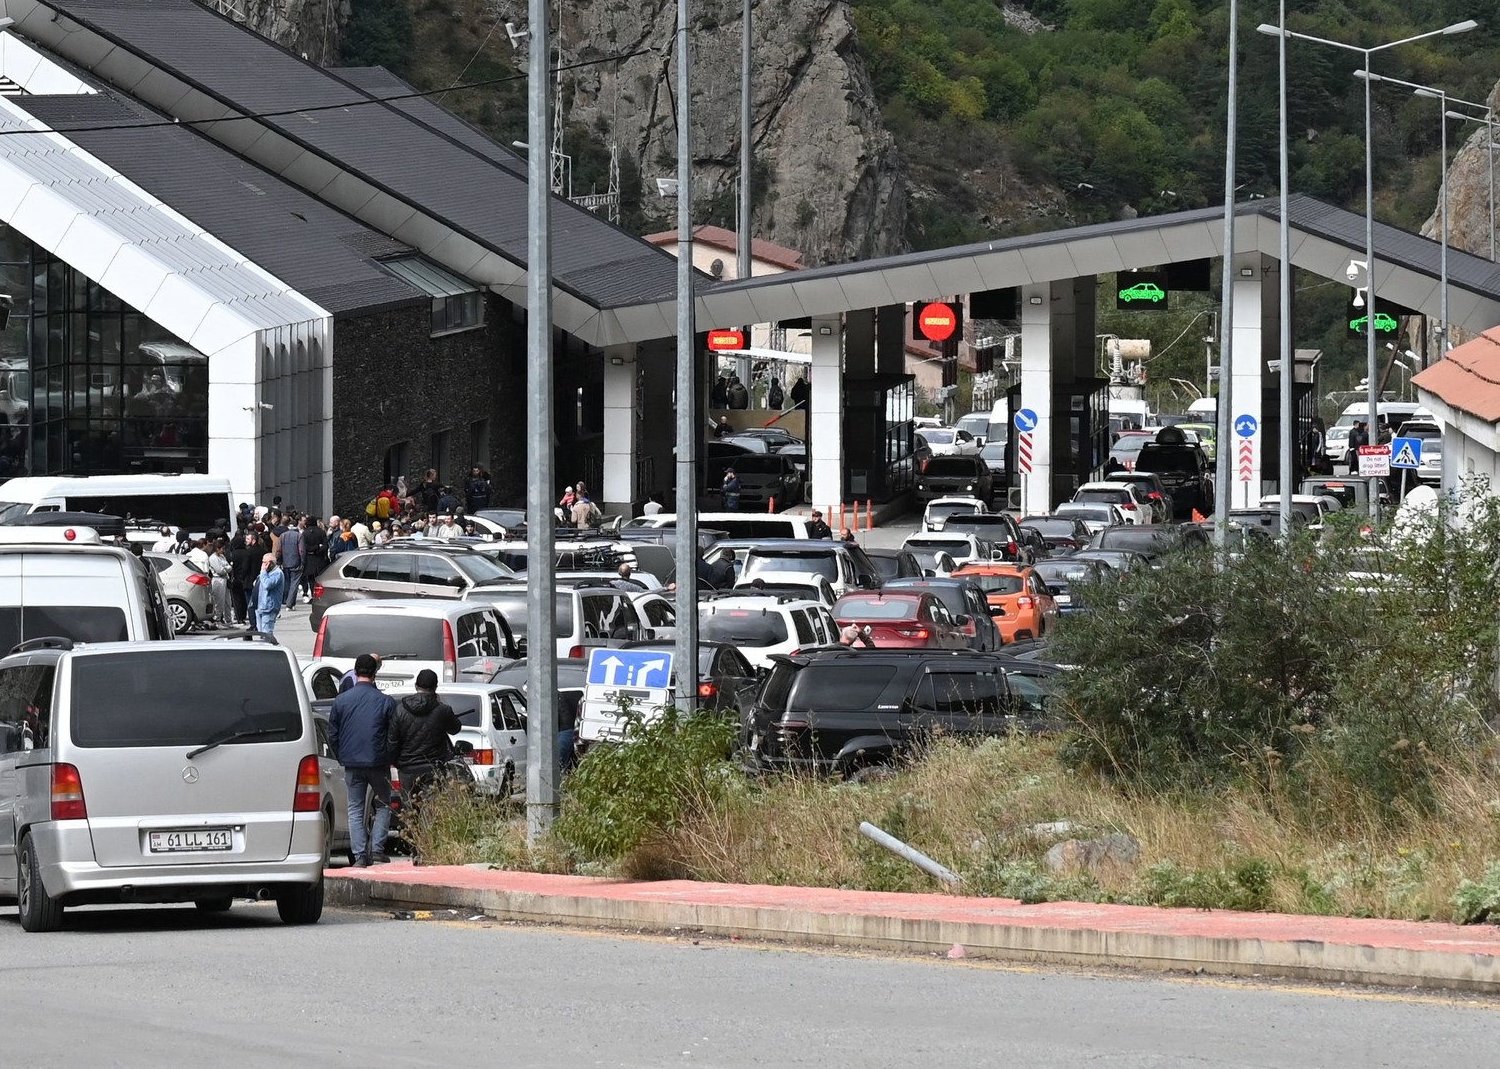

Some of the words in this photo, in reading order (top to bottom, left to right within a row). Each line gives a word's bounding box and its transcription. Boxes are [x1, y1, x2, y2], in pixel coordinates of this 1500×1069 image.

[167, 834, 181, 846] 61
[185, 833, 202, 846] LL
[206, 832, 228, 845] 161
